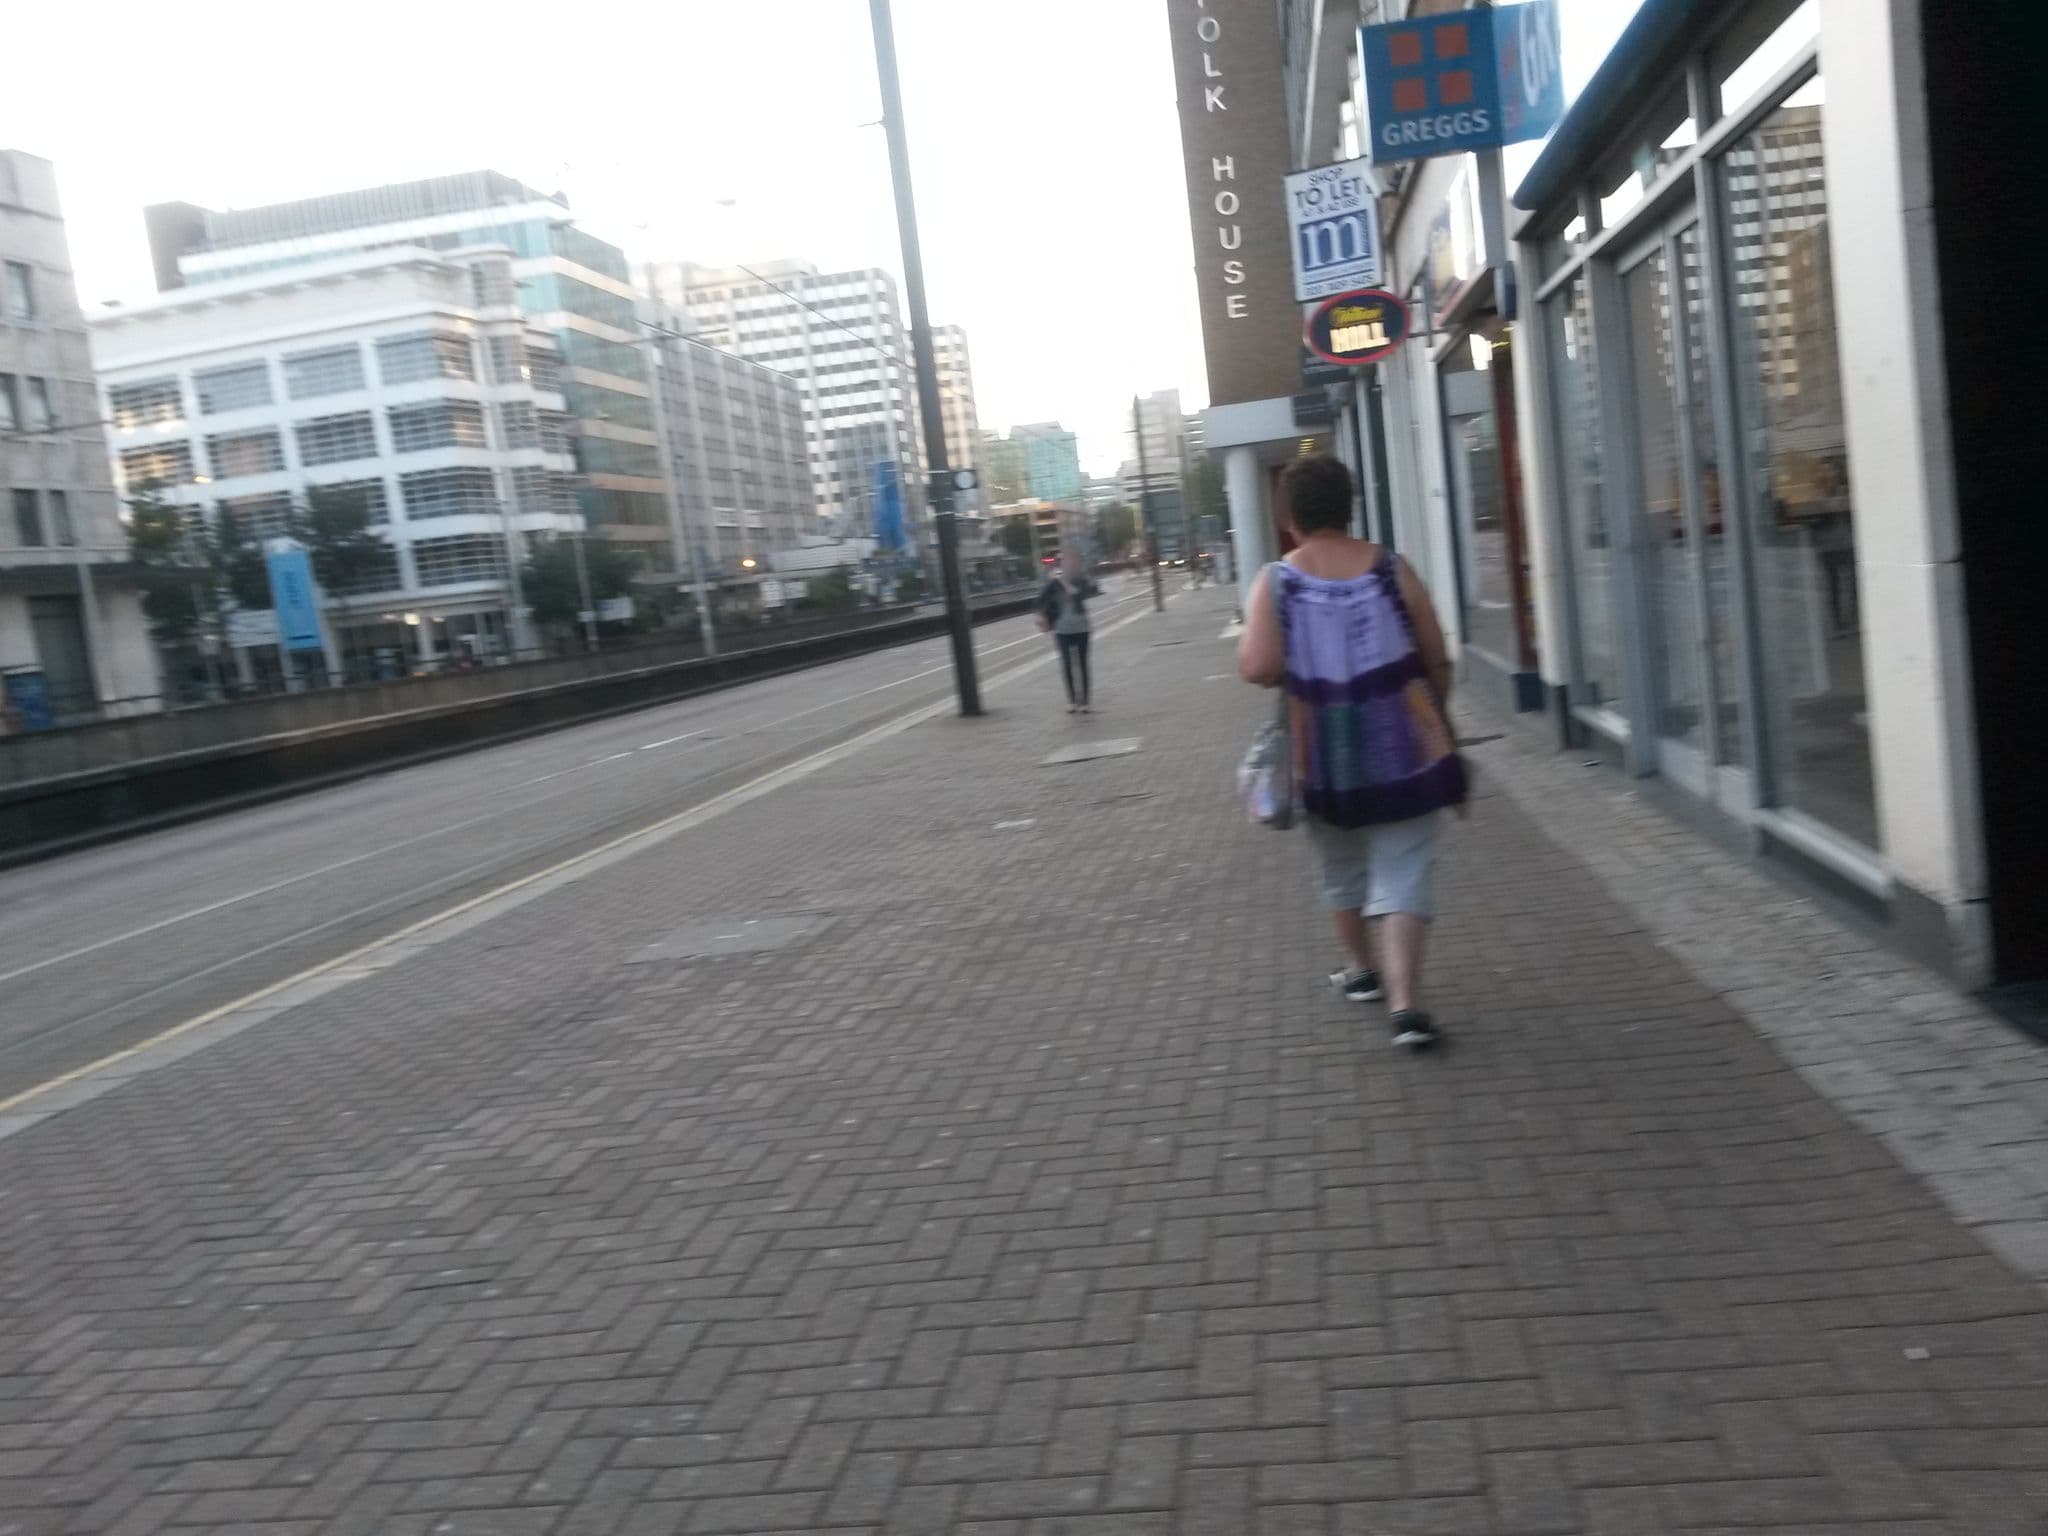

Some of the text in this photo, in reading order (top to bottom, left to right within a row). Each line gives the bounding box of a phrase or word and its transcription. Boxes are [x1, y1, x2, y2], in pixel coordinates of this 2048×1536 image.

[1381, 108, 1492, 147] GREGGS
[1295, 176, 1361, 208] TO LET
[1212, 155, 1249, 319] HOUSE
